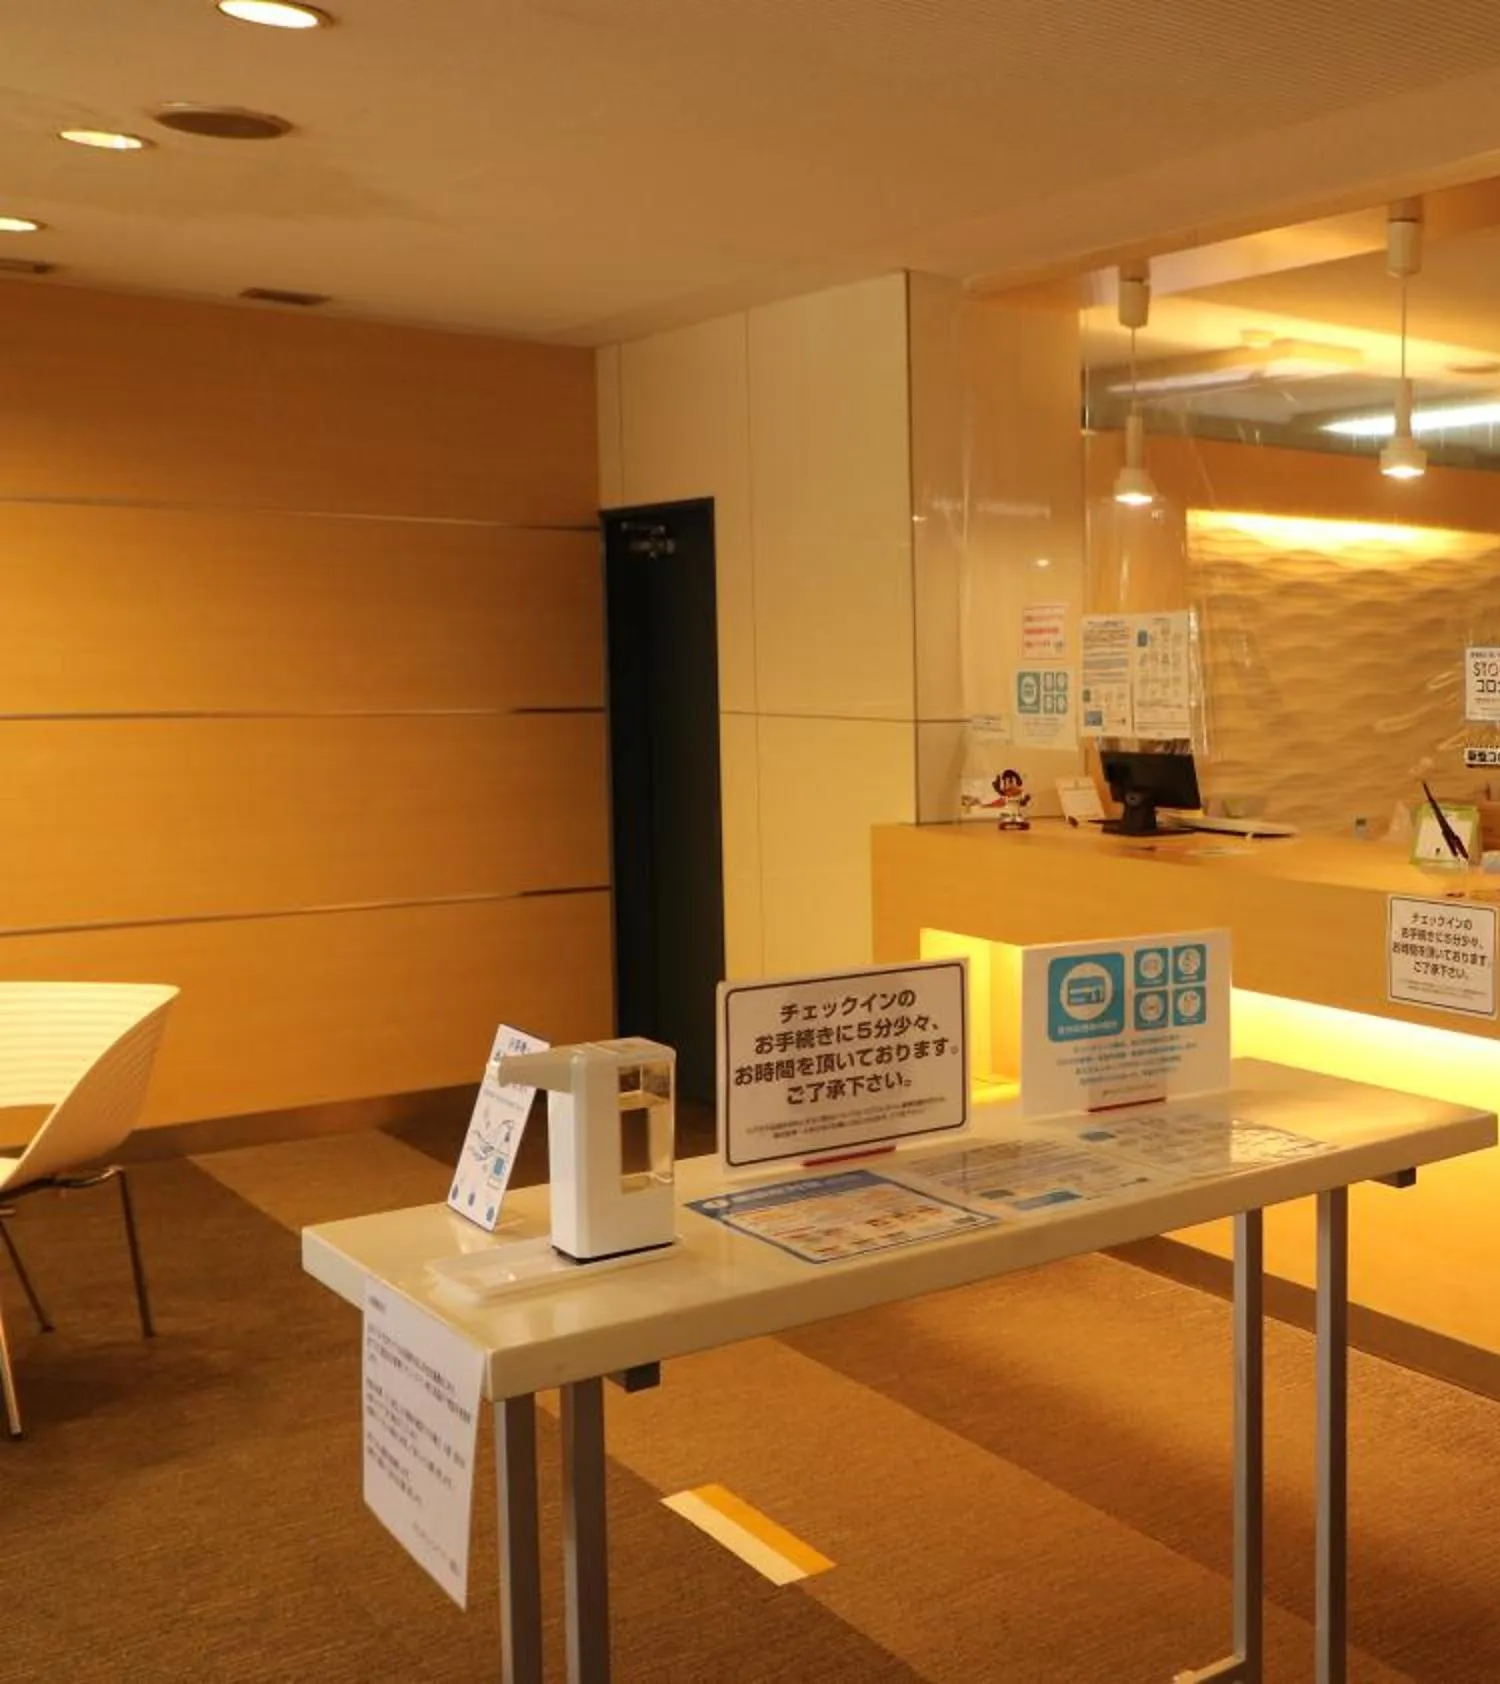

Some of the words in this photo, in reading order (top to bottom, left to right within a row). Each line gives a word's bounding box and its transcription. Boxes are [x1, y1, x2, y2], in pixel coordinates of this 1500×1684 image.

[1411, 913, 1473, 931] チェックインの
[779, 988, 916, 1024] チェックインの
[734, 1036, 960, 1086] お時間を頂いております。
[786, 1071, 912, 1105] ご了承下さい。
